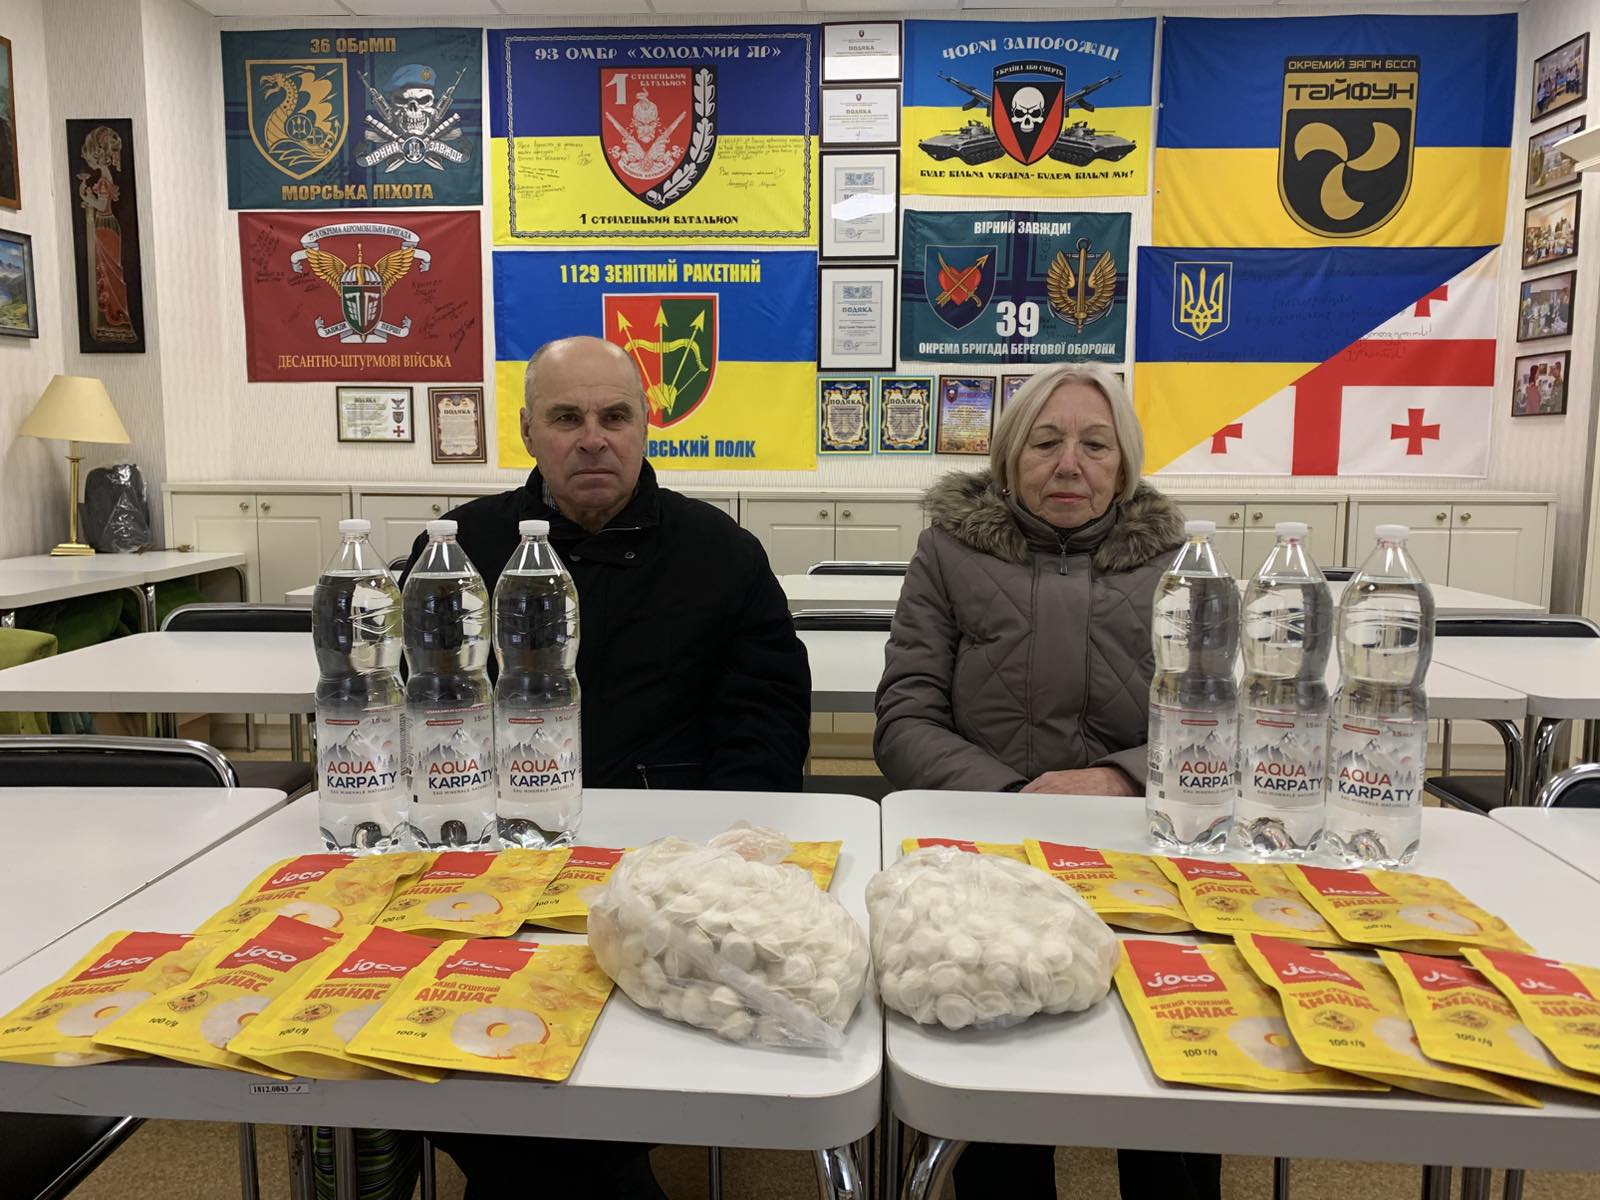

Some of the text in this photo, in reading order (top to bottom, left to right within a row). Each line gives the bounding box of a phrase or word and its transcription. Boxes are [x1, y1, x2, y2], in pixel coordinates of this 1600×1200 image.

[310, 38, 397, 54] 36 ОБрМП
[535, 47, 559, 60] 93
[942, 36, 1120, 62] ЧОРНІ ЗАПОРОЖЦІ
[995, 63, 1024, 77] УКРАЇНА
[1038, 64, 1064, 77] СМЕРТЬ
[1289, 57, 1345, 70] ОКРЕМИЙ
[606, 73, 628, 105] 1
[365, 140, 463, 167] ВІРНИЙ ЗАВЖДИ
[919, 169, 945, 177] БУДЕ
[949, 169, 985, 178] ВІЛЬНА
[1037, 171, 1072, 180] БУДЕМ
[1075, 170, 1109, 180] ВІЛЬНІ
[282, 183, 434, 201] МОРСЬКА ПІХОТА
[579, 213, 739, 225] 1 СТРІЛЕЦЬКИЙ БАТАЛЬЙОН
[974, 218, 1072, 237] ВІРНИЙ ЗАВЖДИ!
[560, 258, 762, 284] 1129 ЗЕНІТНИЙ РАКЕТНИЙ
[995, 300, 1040, 338] 39
[919, 340, 1116, 356] ОКРЕМА БРИГАДА БЕРЕГОВОЇ ОБОРОНИ
[278, 351, 453, 371] ДЕСАНТНО-ШТУРМОВІ ВІЙСЬКА
[644, 434, 757, 458] ВСЬКИЙ ПОЛК
[327, 760, 377, 775] AQUA
[429, 758, 479, 774] AQUA
[510, 759, 559, 773] AQUA
[1180, 760, 1228, 774] AQUA
[1255, 761, 1307, 777] AQUA
[327, 770, 398, 789] KARPATY
[428, 767, 494, 789] KARPATY
[510, 768, 577, 787] KARPATY
[1179, 773, 1235, 788] KARPAT
[1253, 775, 1323, 791] KARPATY
[1339, 766, 1393, 787] AQUA
[1338, 780, 1415, 802] KARPATY
[271, 870, 326, 885] joco
[423, 870, 477, 879] joco
[1187, 867, 1243, 878] joco
[1195, 884, 1261, 897] АНАНАС
[233, 945, 298, 963] joco
[88, 956, 156, 973] joco
[342, 958, 408, 974] joco
[446, 958, 512, 972] joco
[1147, 971, 1216, 988] joco
[304, 987, 388, 1001] АНАНАС
[414, 987, 499, 1005] АНАНАС
[1297, 993, 1381, 1012] АНАНАС
[1155, 1006, 1239, 1020] АНАНАС
[1329, 1038, 1349, 1047] 100
[1183, 1048, 1203, 1058] 100
